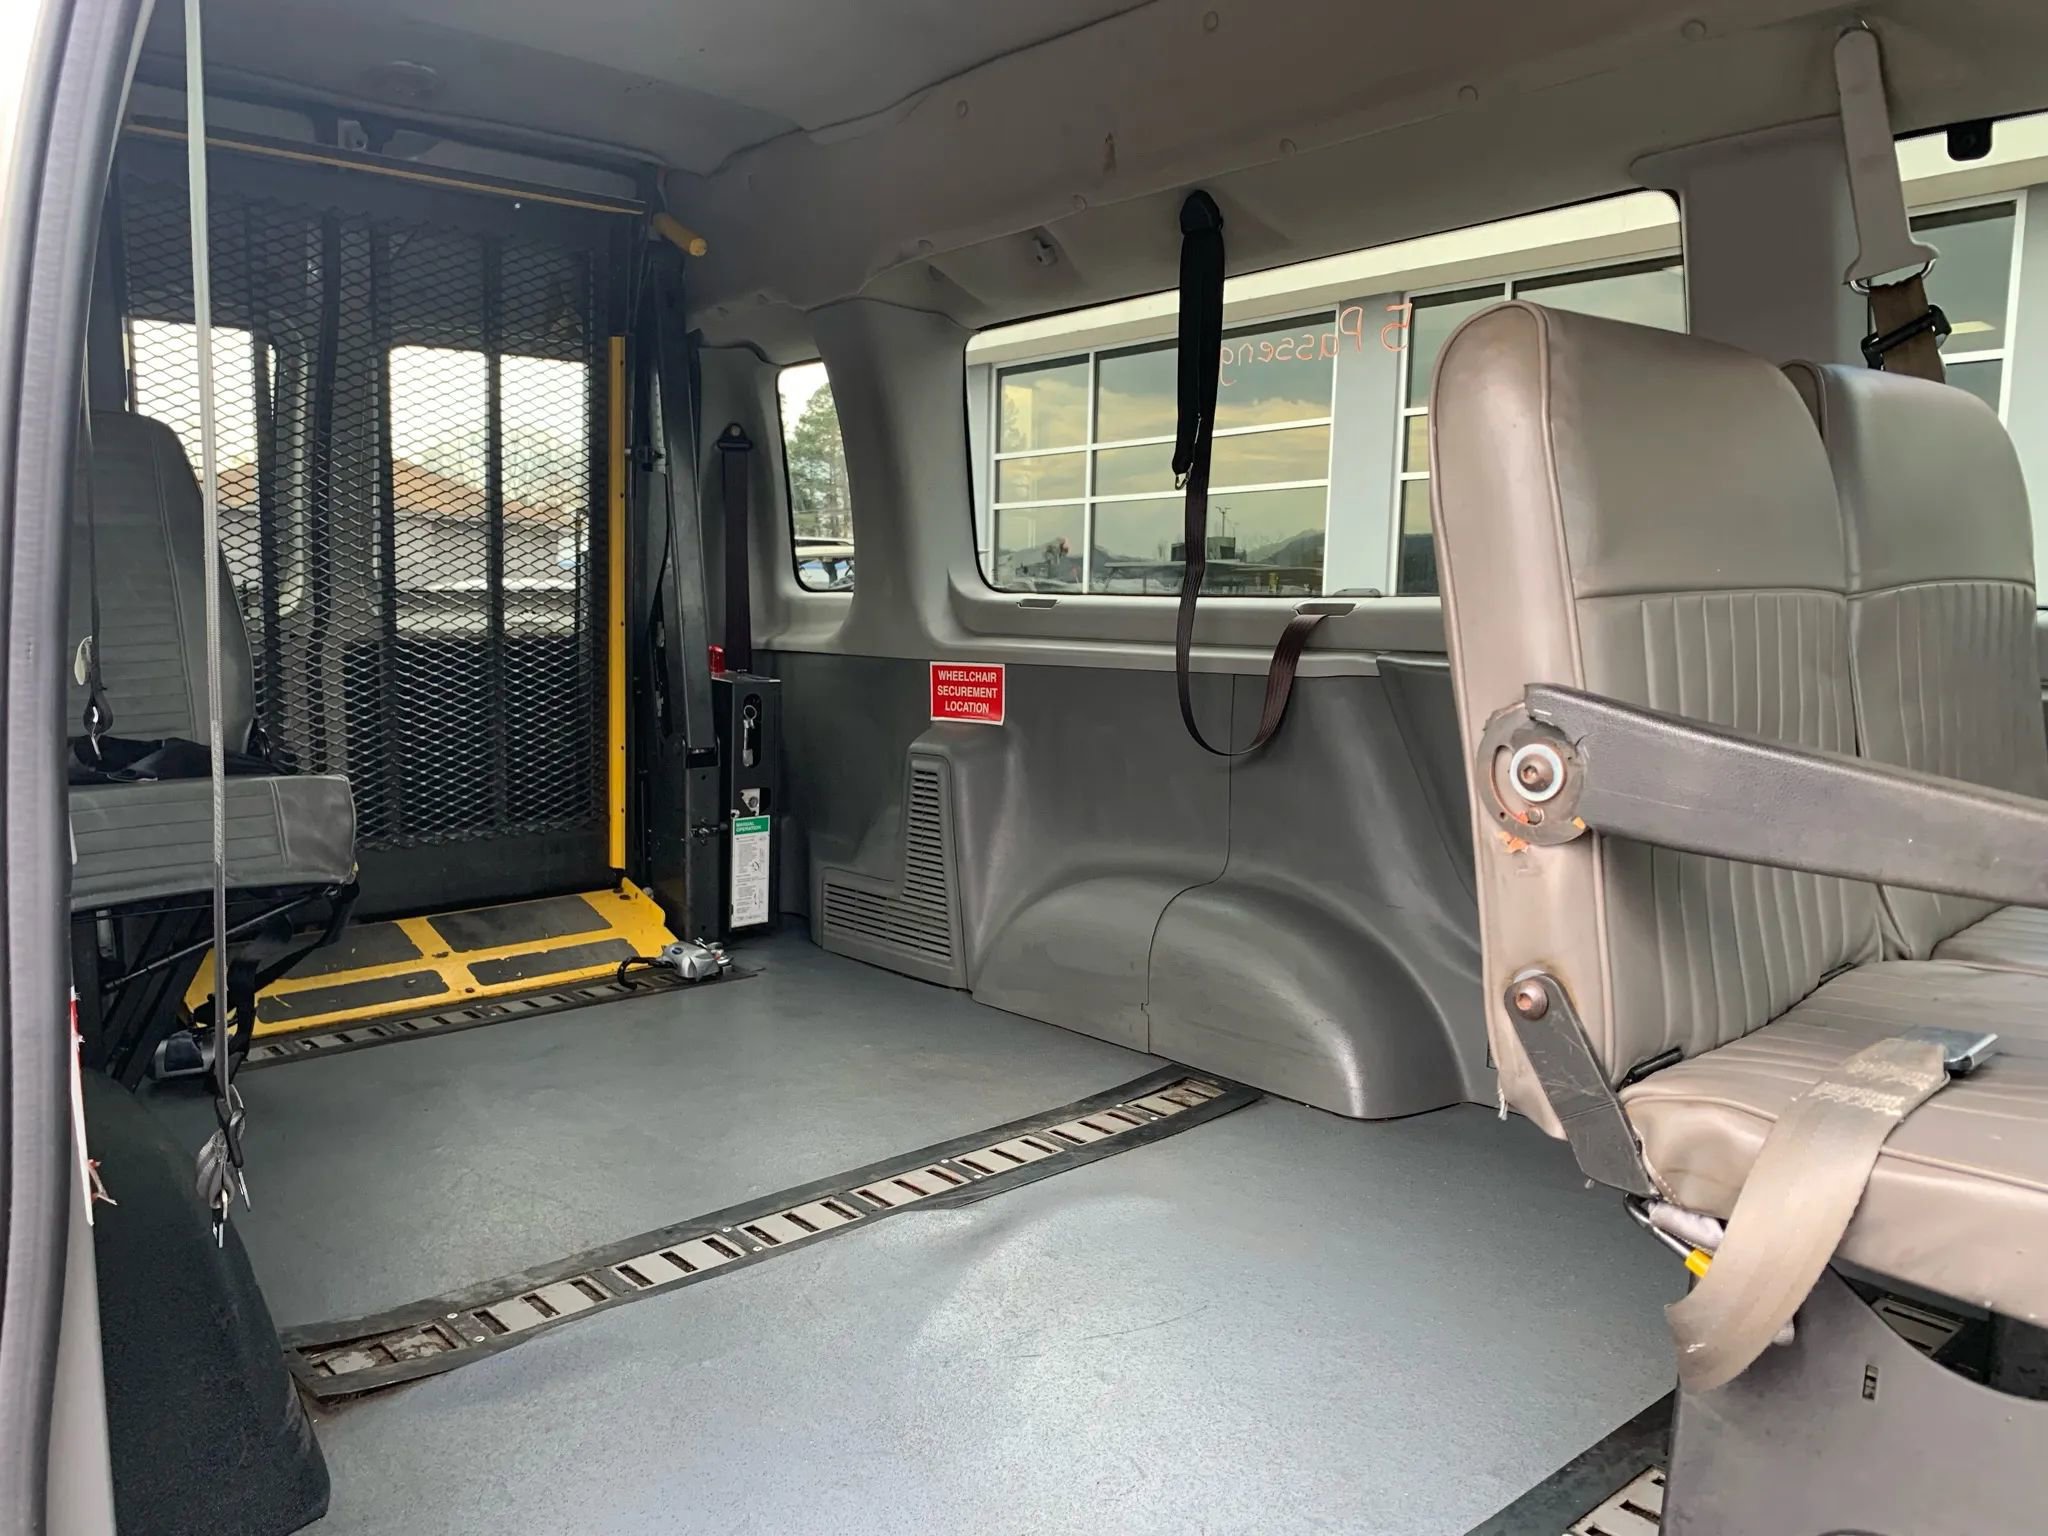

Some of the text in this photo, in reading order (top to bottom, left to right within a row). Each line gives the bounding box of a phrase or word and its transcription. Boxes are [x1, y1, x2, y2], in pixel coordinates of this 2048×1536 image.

[938, 670, 997, 683] WHEELCHAIR
[937, 685, 998, 699] SECUREMENT
[944, 701, 990, 714] LOCATION
